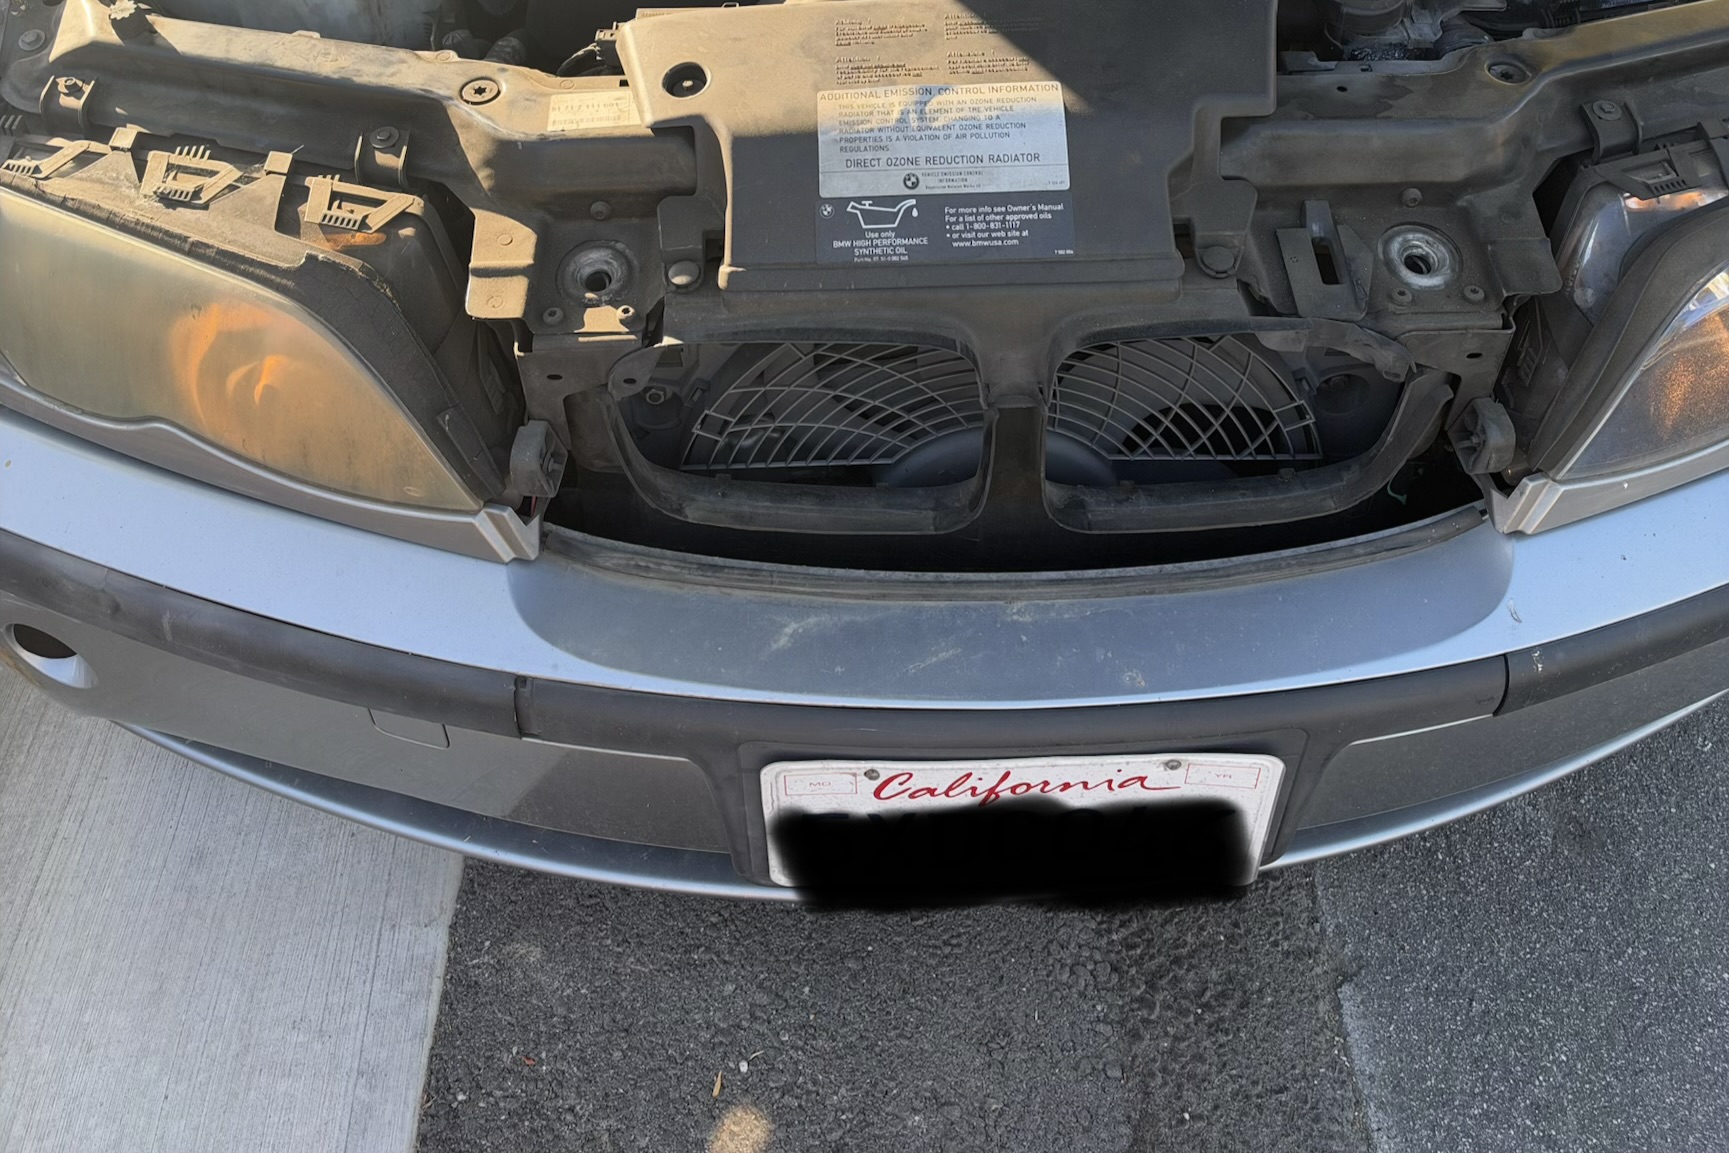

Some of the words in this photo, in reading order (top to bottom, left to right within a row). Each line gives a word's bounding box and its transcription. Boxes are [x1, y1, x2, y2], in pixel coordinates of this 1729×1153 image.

[820, 92, 881, 101] ADDITIONAL
[884, 88, 932, 98] EMISSION
[938, 87, 986, 96] CONTROL
[988, 84, 1059, 94] INFORMATION
[839, 119, 873, 127] EMISSION
[911, 124, 956, 132] EQUIVALENT
[985, 122, 1027, 130] REDUCTION
[839, 136, 883, 144] PROPERTIES
[970, 131, 1011, 140] POLLUTION
[845, 157, 882, 168] DIRECT
[886, 156, 921, 167] OZONE
[925, 154, 984, 166] REDUCTION
[988, 152, 1040, 164] RADIATOR
[944, 206, 957, 214] For
[978, 205, 992, 213] info
[1007, 203, 1036, 212] Owner's
[1037, 203, 1064, 211] Manual
[964, 214, 976, 222] list
[977, 214, 985, 222] of
[985, 213, 1004, 221] other
[1005, 212, 1038, 221] approved
[951, 223, 964, 231] call
[966, 221, 1021, 230] 1-800-831-1117
[865, 231, 879, 239] Use
[880, 230, 896, 239] only
[1007, 229, 1020, 237] site
[1021, 229, 1029, 237] at
[833, 240, 851, 248] BMW
[853, 239, 871, 247] HIGH
[873, 237, 928, 247] PERFORMANCE
[952, 238, 1019, 247] www.bmwusa.com
[854, 247, 894, 256] SYNTHETIC
[873, 768, 1181, 807] California
